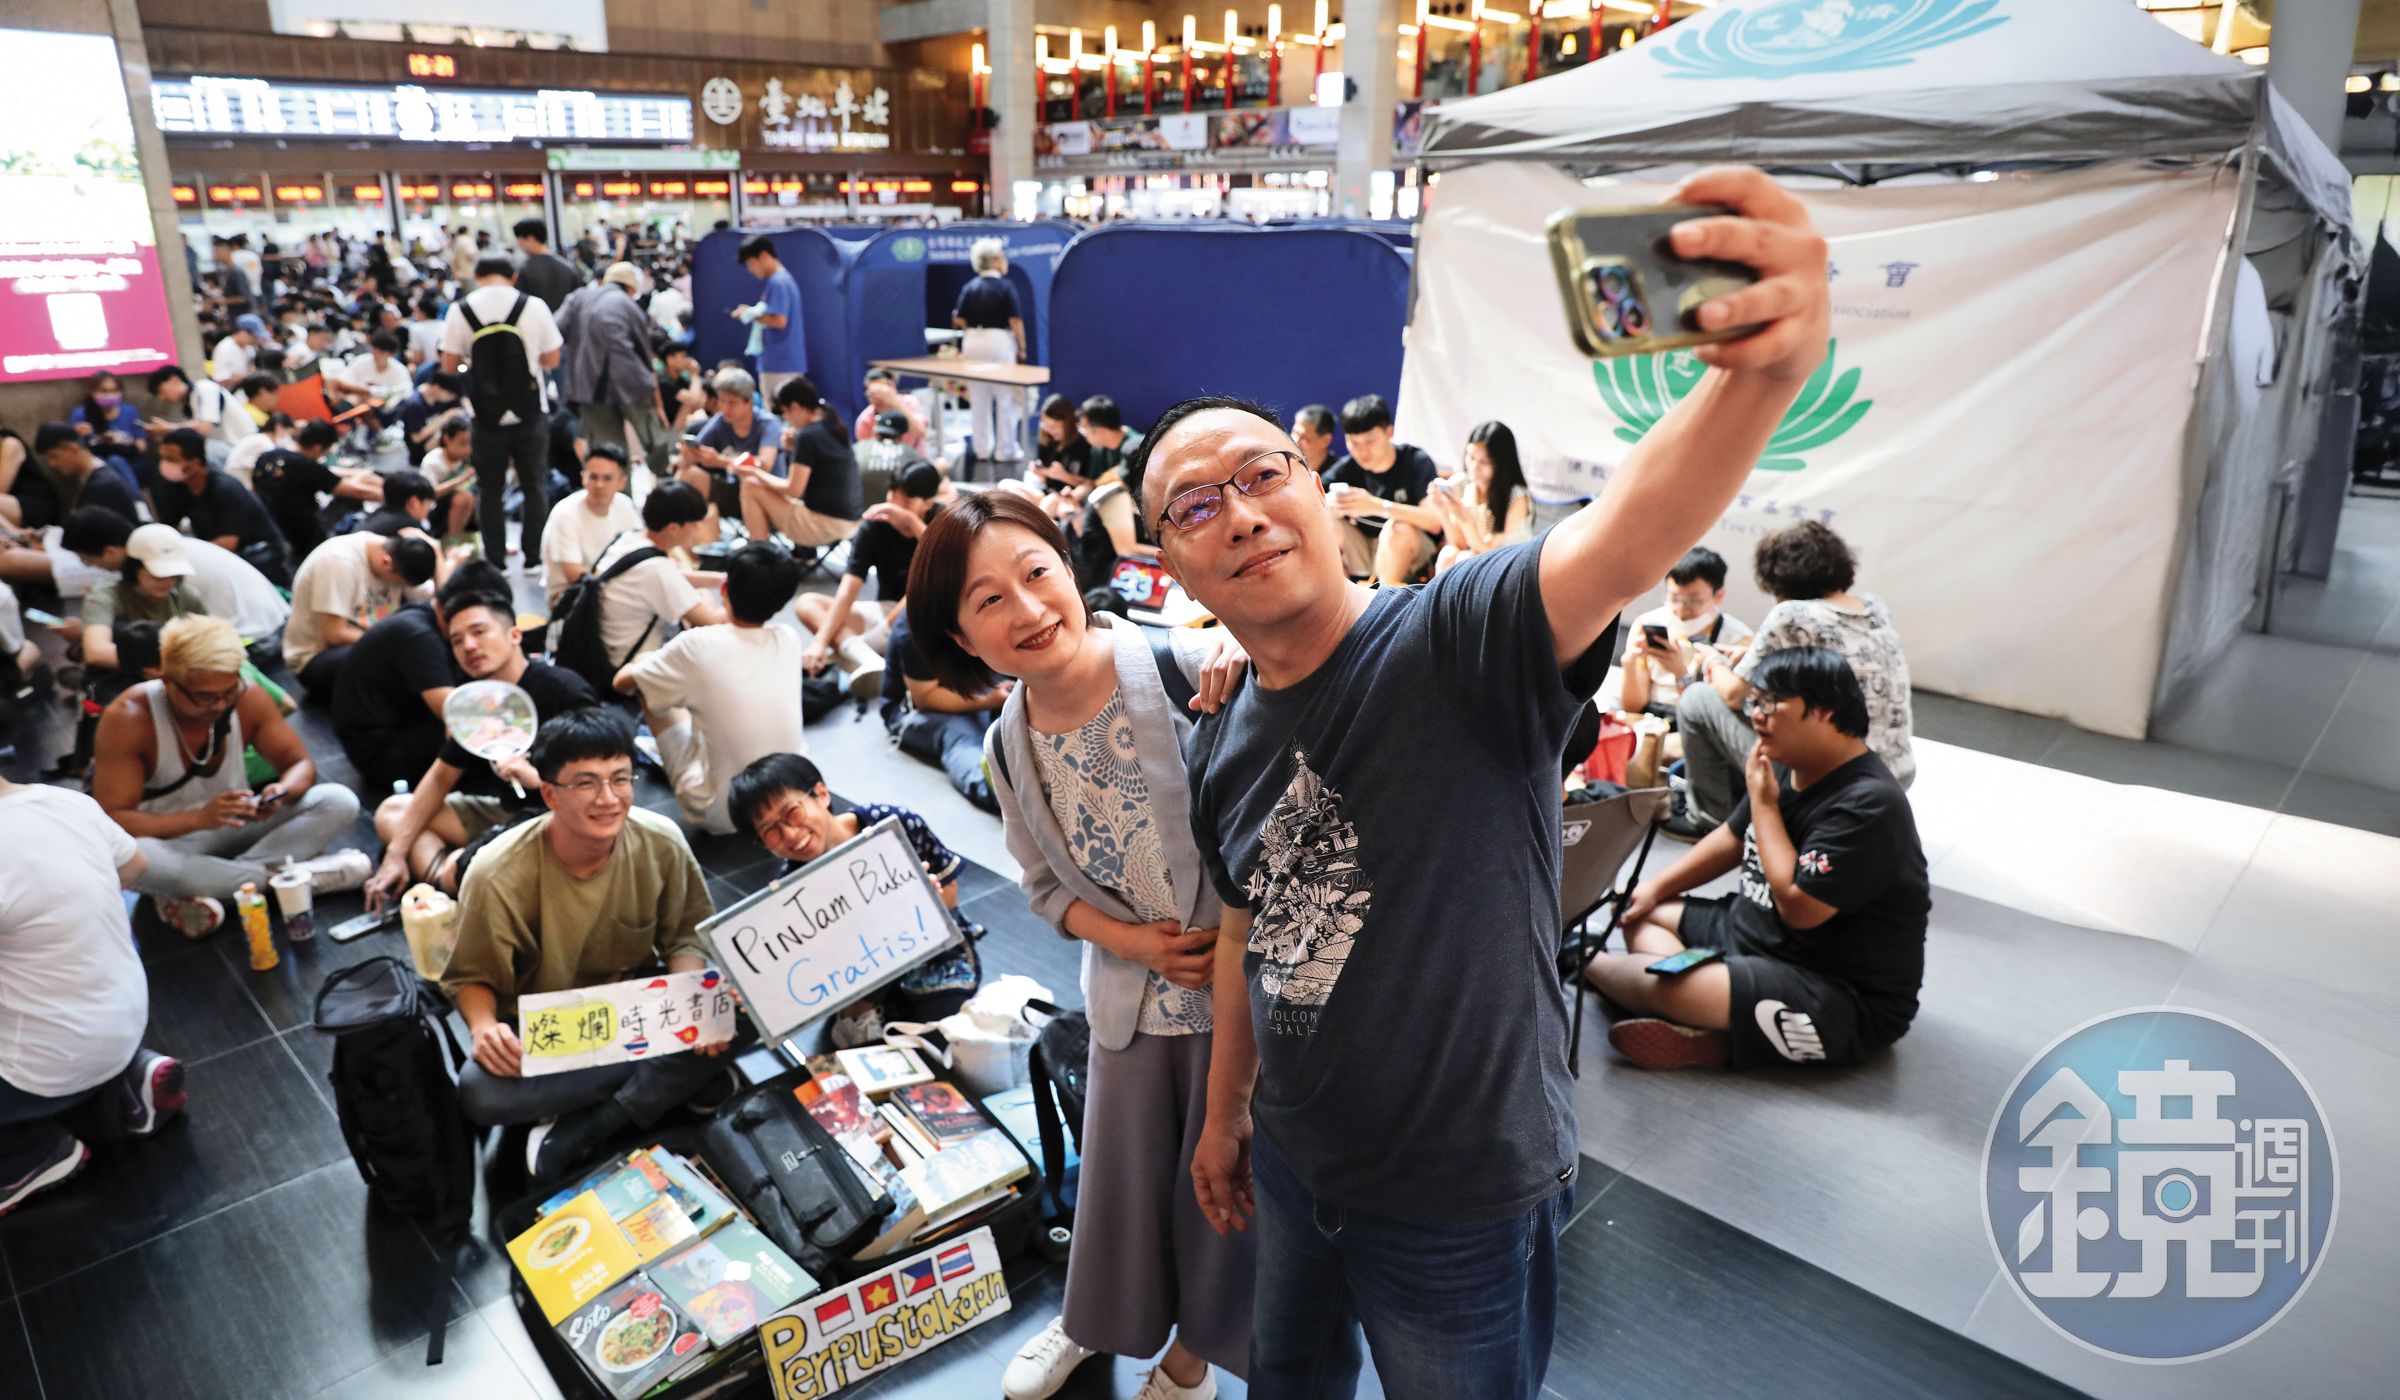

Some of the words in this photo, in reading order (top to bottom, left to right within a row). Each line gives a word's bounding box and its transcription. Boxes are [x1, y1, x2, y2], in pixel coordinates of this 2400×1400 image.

[848, 853, 917, 905] Buku
[787, 905, 931, 1007] Gratis!
[527, 989, 731, 1055] 燦爛時光書店
[1267, 1009, 1318, 1023] VOLCOM
[568, 1303, 611, 1350] Soto
[758, 1270, 1007, 1400] Perpustakaan
